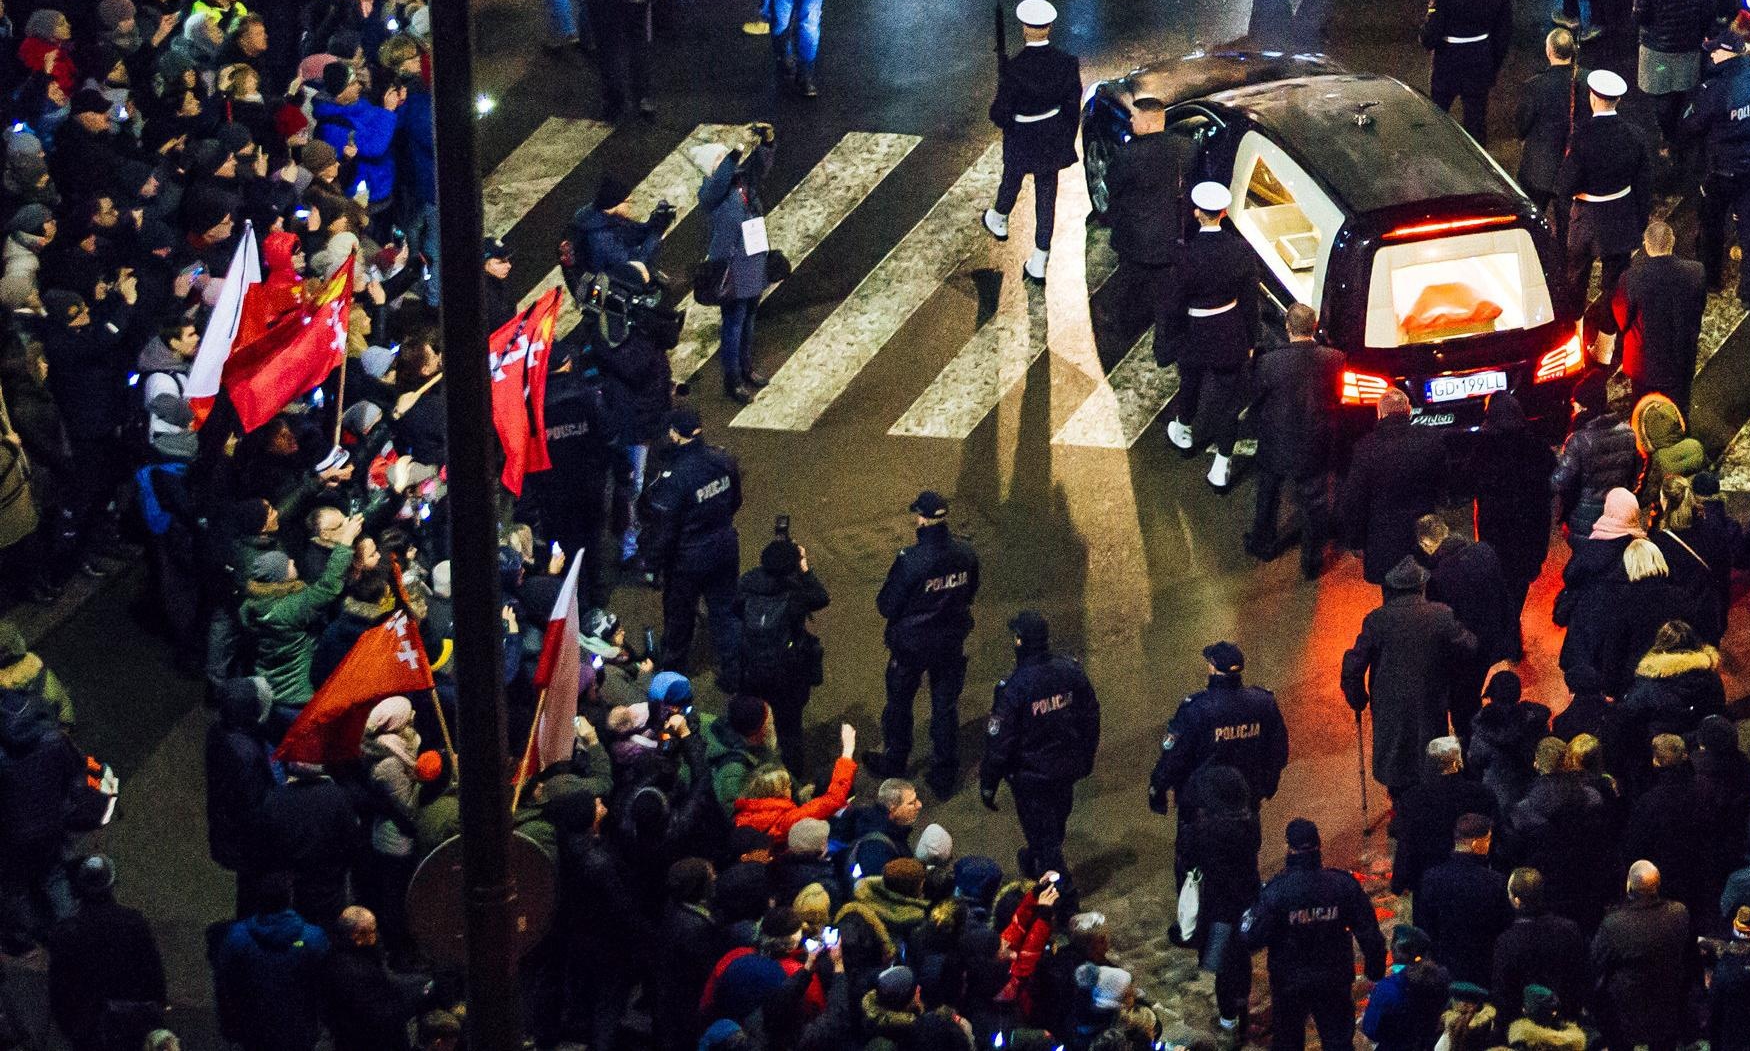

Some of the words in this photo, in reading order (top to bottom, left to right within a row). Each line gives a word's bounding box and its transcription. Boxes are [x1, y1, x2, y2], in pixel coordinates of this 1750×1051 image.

[1434, 381, 1455, 396] GD
[1462, 374, 1504, 394] 199LL
[925, 571, 968, 592] POLICJA
[1215, 723, 1260, 742] POLICJA
